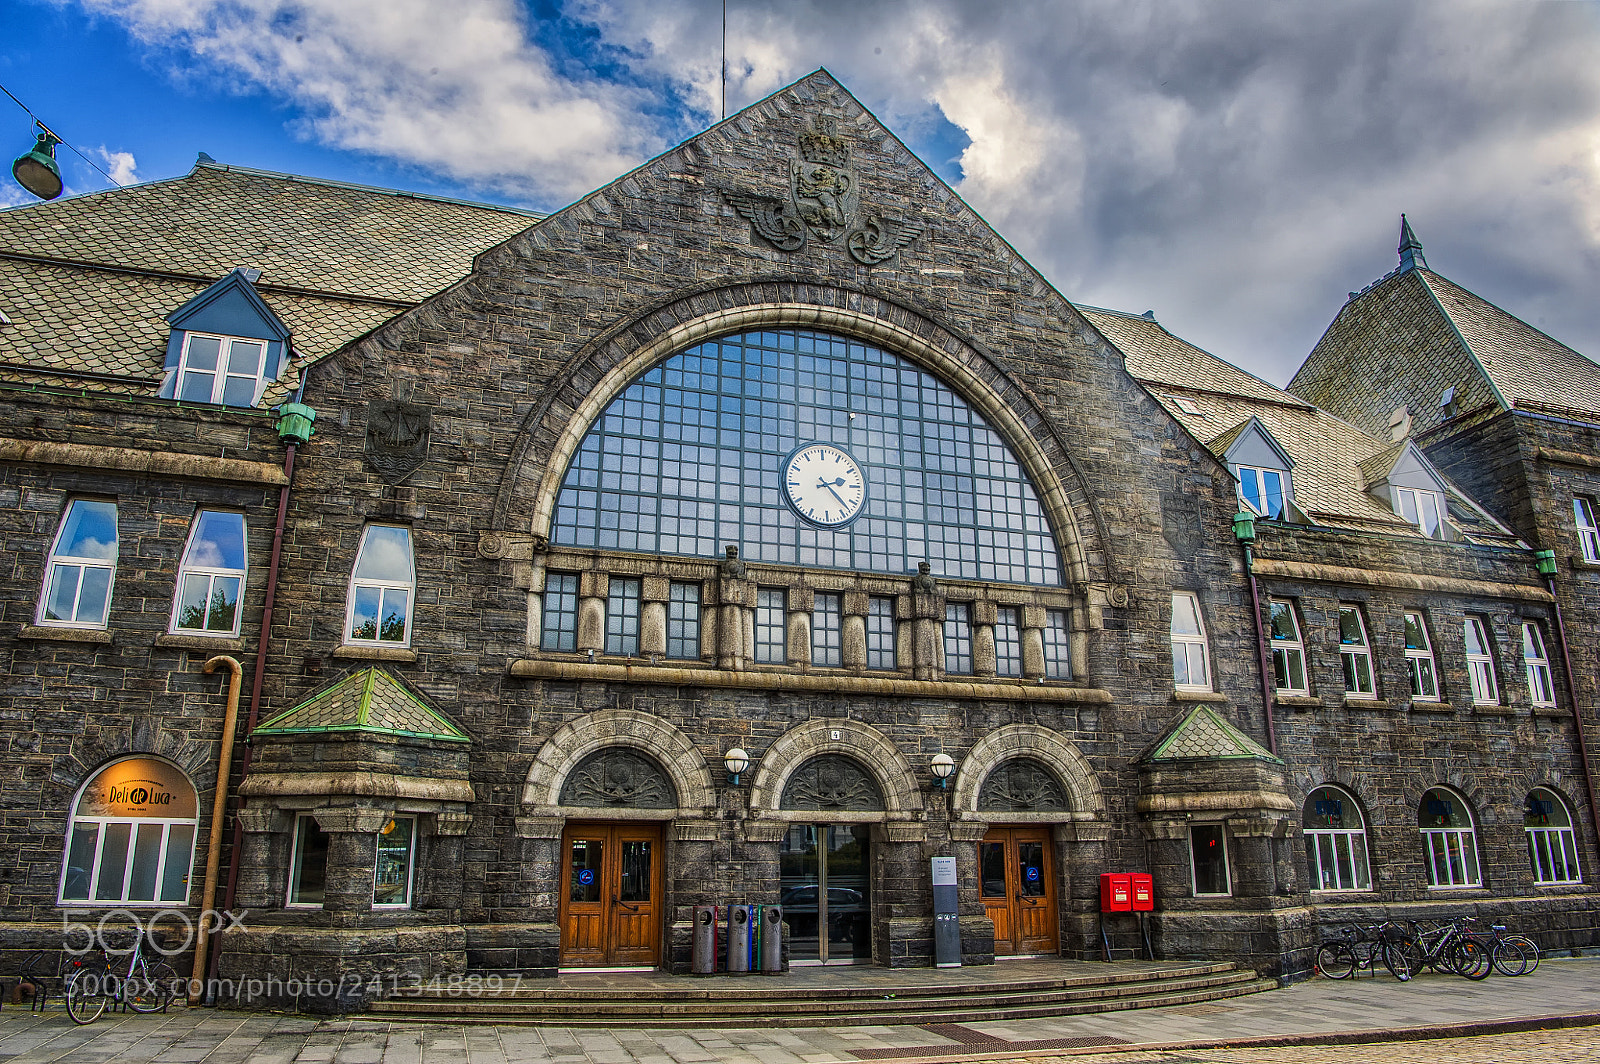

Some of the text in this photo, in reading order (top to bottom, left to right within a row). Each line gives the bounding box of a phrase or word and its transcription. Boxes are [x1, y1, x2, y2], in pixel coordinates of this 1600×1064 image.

[109, 786, 171, 804] Deli de Luca
